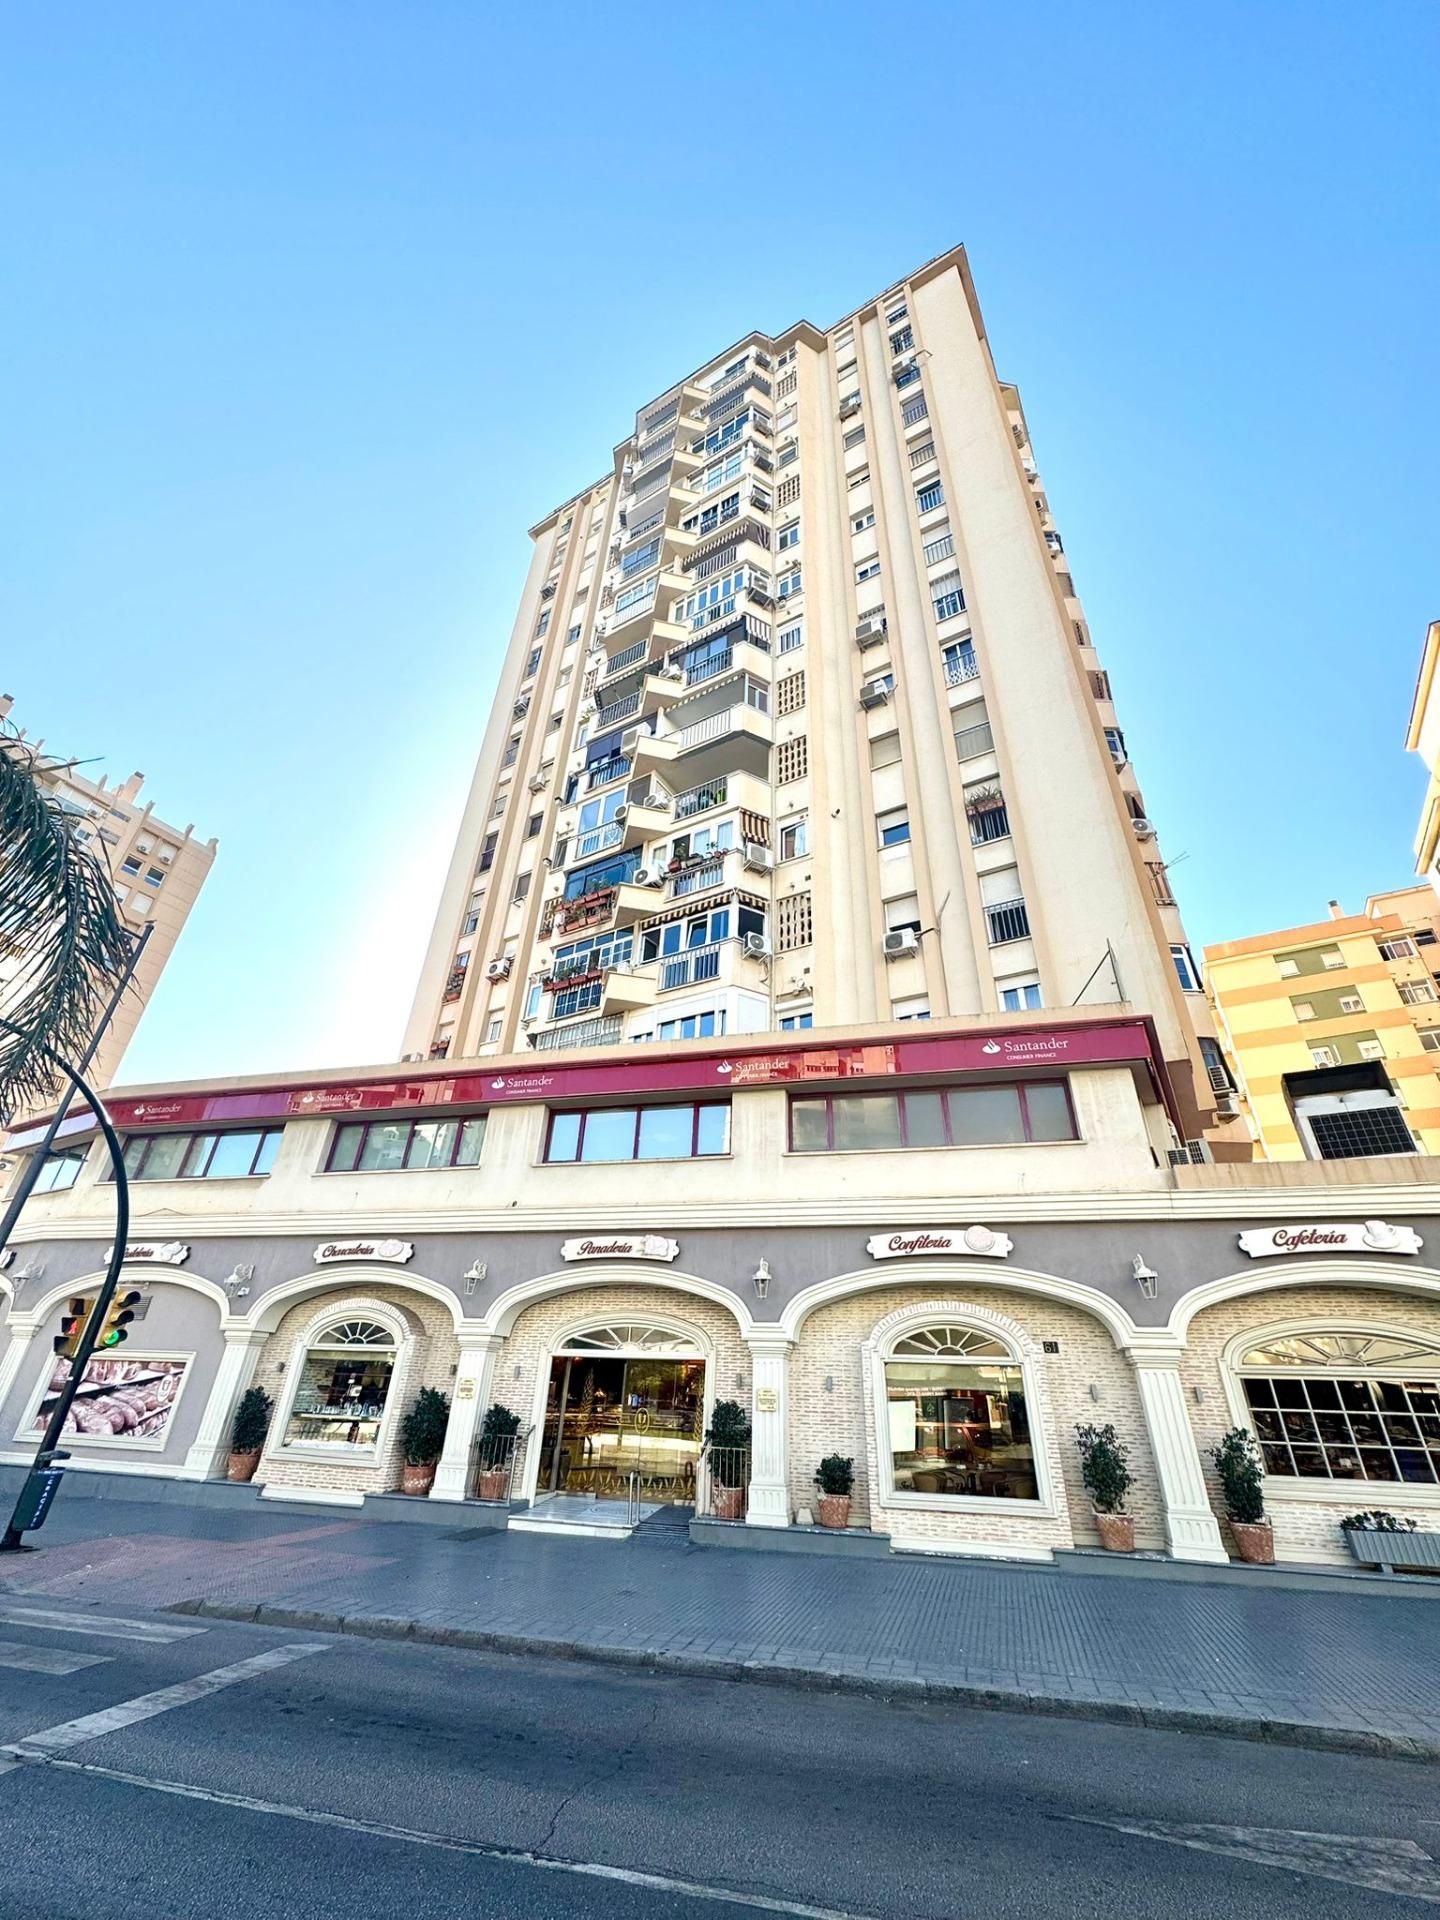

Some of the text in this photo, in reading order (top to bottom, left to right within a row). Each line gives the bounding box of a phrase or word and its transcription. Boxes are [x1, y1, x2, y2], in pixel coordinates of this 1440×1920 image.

[1004, 1037, 1069, 1053] Santander
[735, 1059, 790, 1072] Santander
[506, 1075, 554, 1088] Santander
[316, 1090, 356, 1102] Santander
[145, 1103, 181, 1114] Santander
[1272, 1228, 1348, 1251] Cafetería
